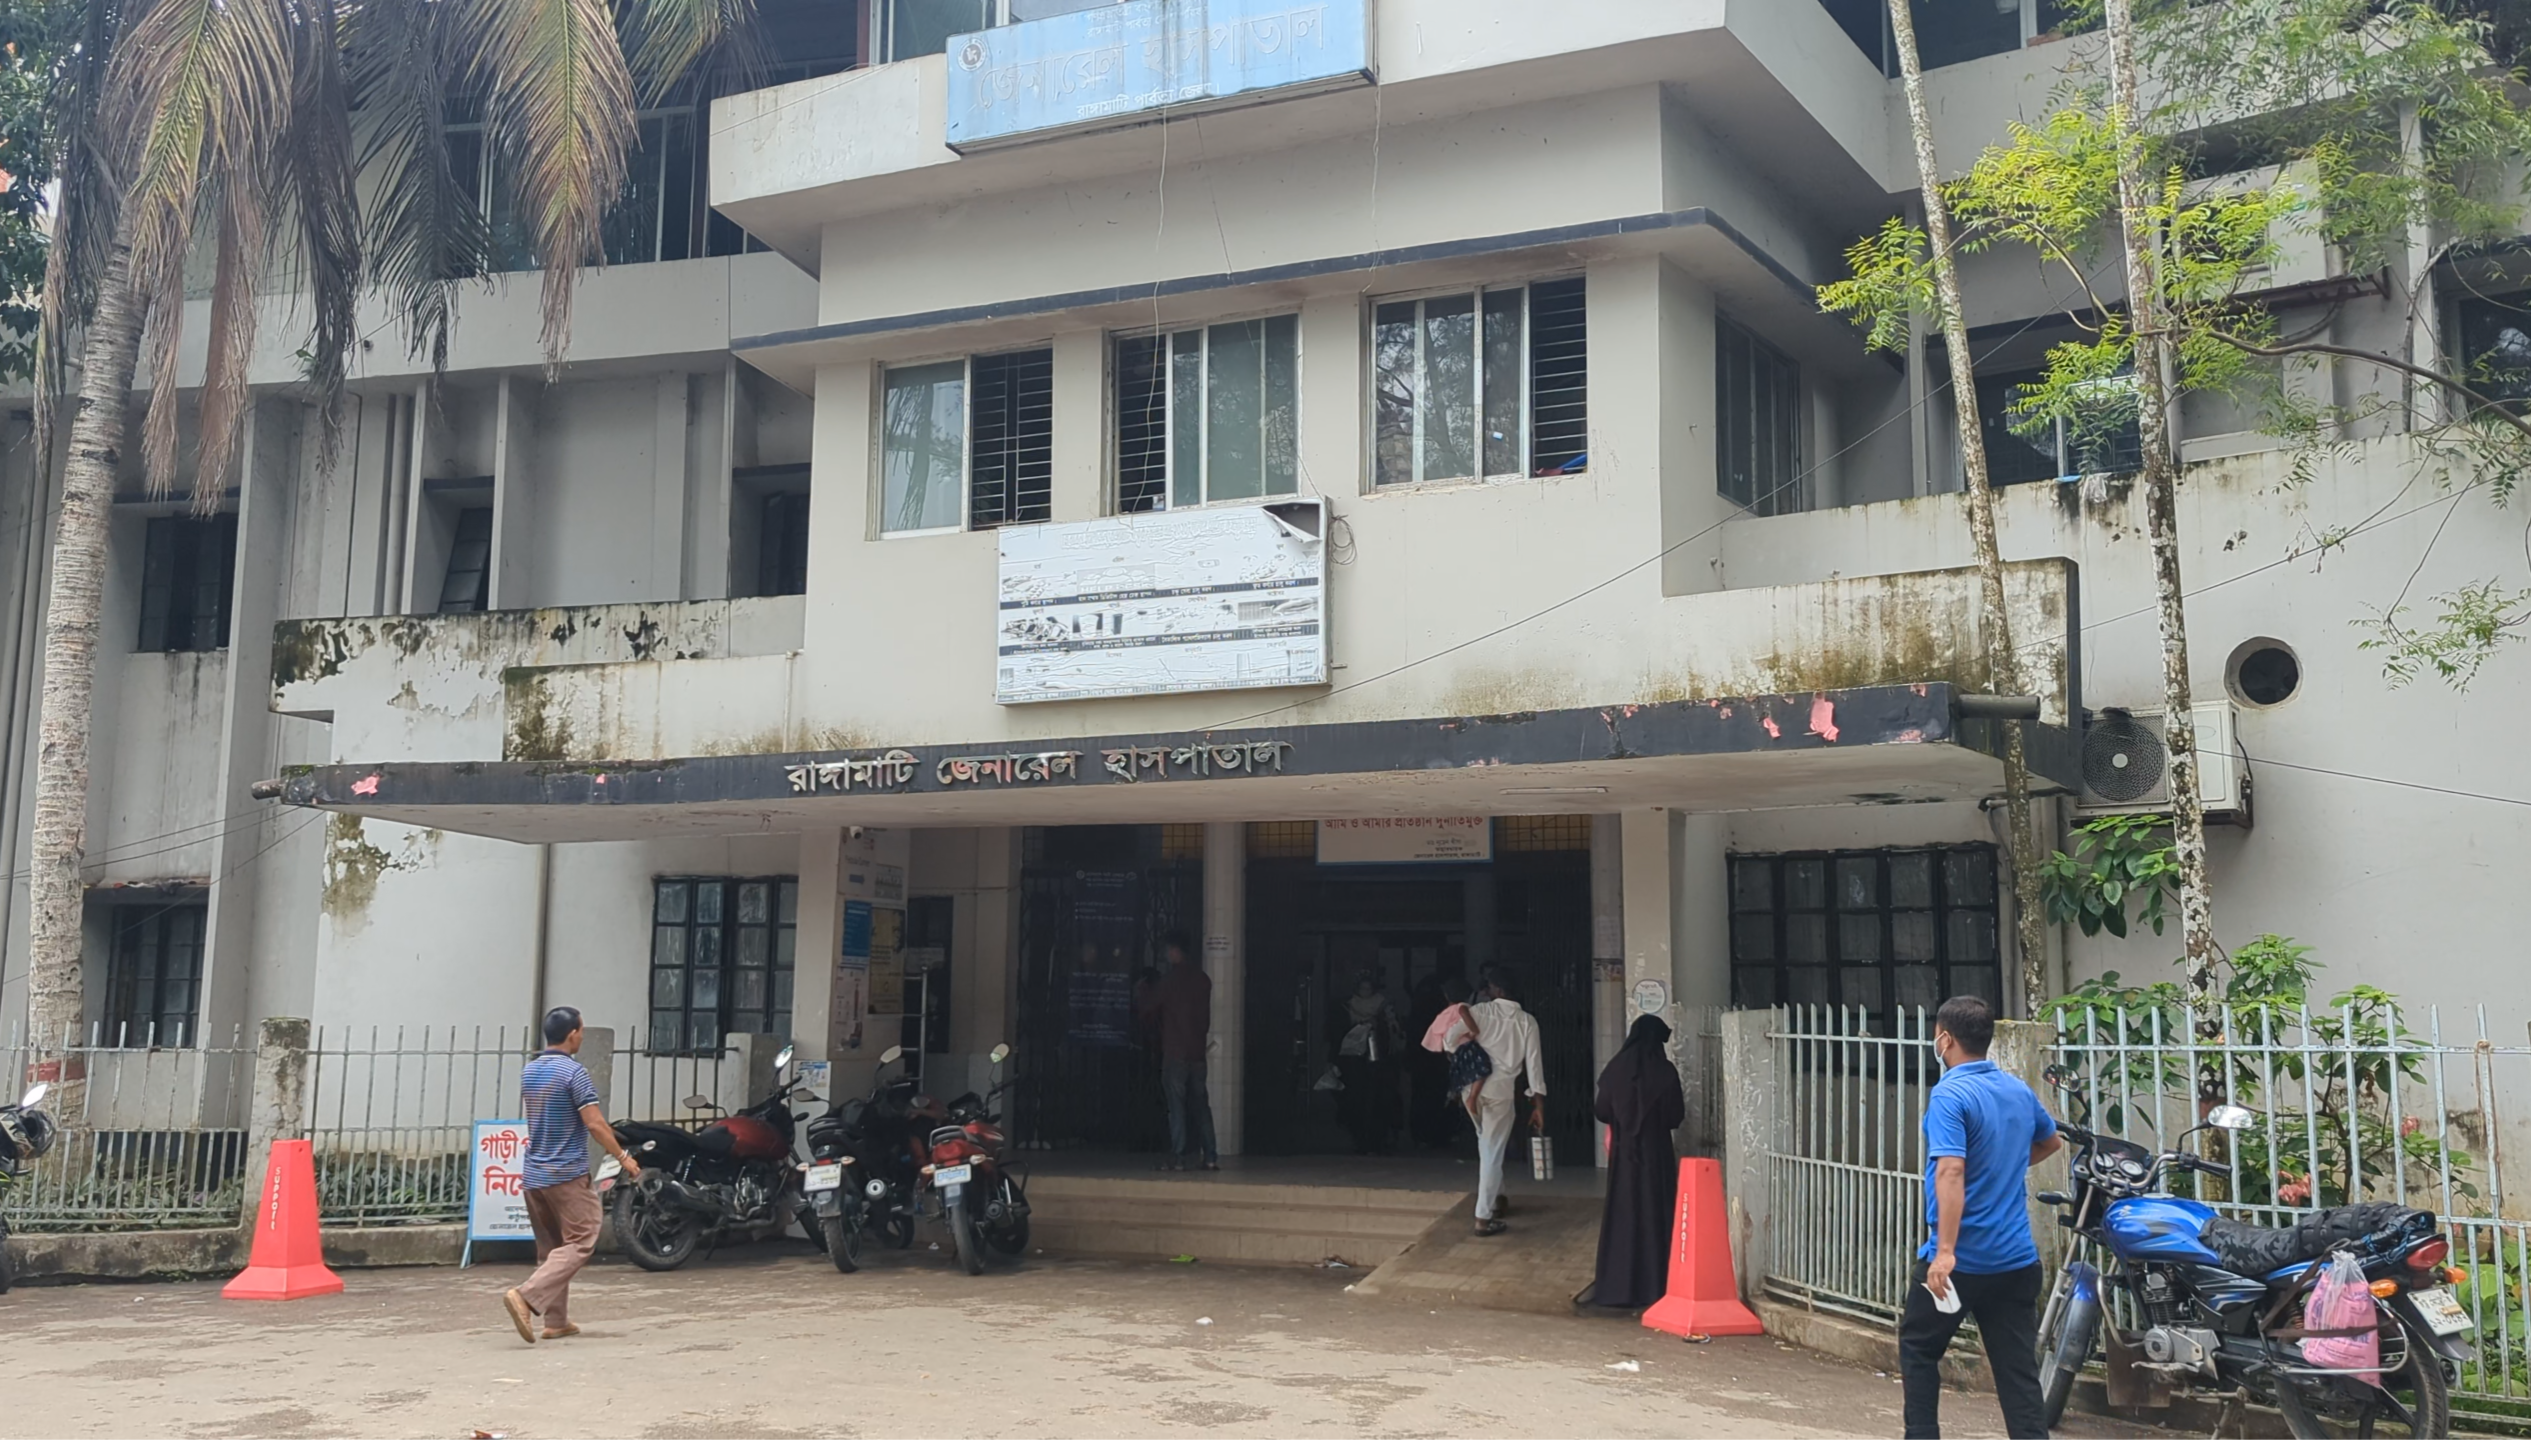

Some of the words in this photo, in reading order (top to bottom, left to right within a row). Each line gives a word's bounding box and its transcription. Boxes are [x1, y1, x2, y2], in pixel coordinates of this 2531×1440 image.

[1076, 94, 1130, 119] রাঙ্গামাটি
[1133, 84, 1174, 107] পার্বত্য
[784, 749, 923, 793] রাঙ্গামাটি
[935, 750, 1084, 785] জেনারেল
[1100, 739, 1296, 784] হাসপাতাল
[1361, 817, 1391, 829] আমার
[481, 1129, 518, 1164] গাড়ী
